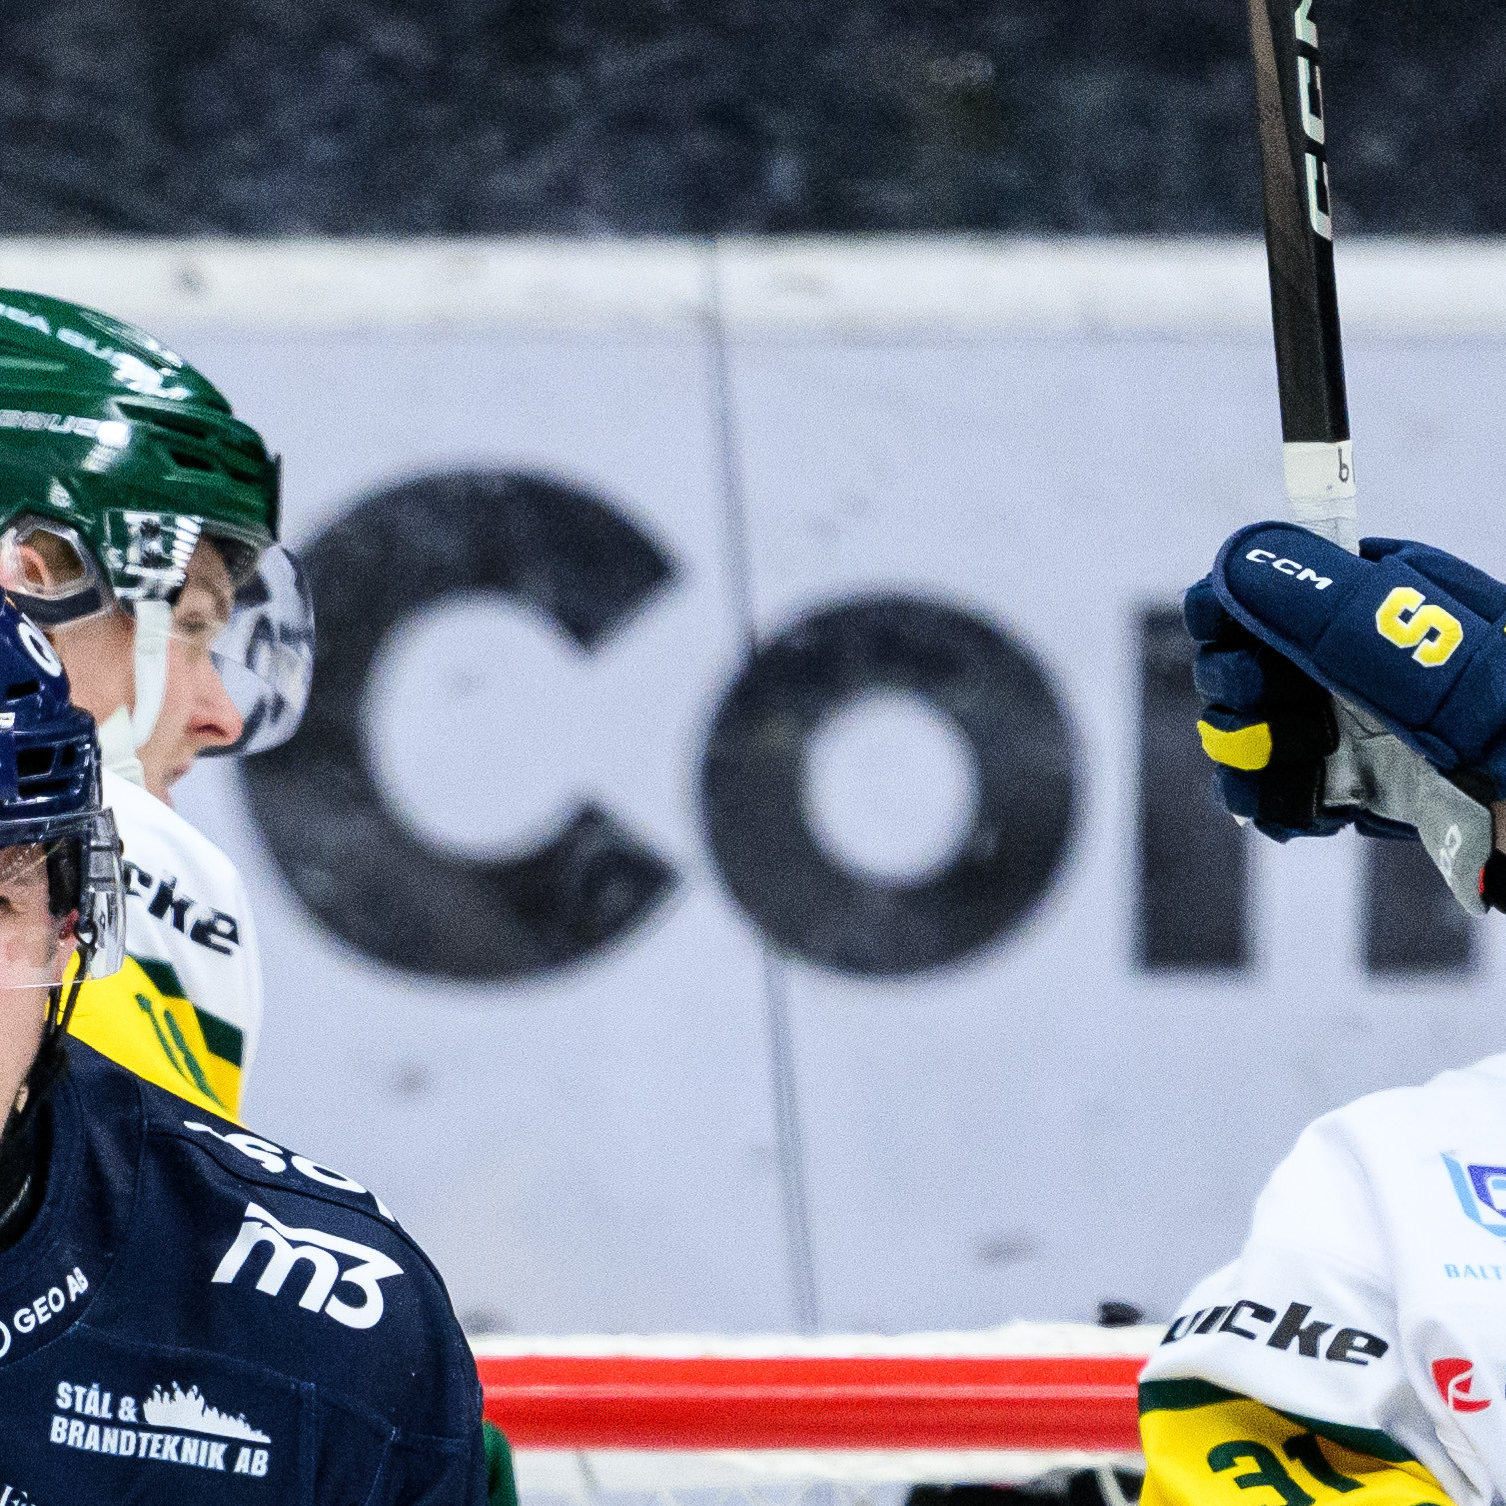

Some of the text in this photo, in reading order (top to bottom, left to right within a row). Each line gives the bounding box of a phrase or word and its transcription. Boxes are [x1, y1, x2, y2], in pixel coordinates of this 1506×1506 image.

[1245, 548, 1334, 592] CCM
[13, 1286, 66, 1334] GEO
[55, 1381, 138, 1424] STÅL &
[49, 1416, 270, 1479] BRANDTEKNIK AB
